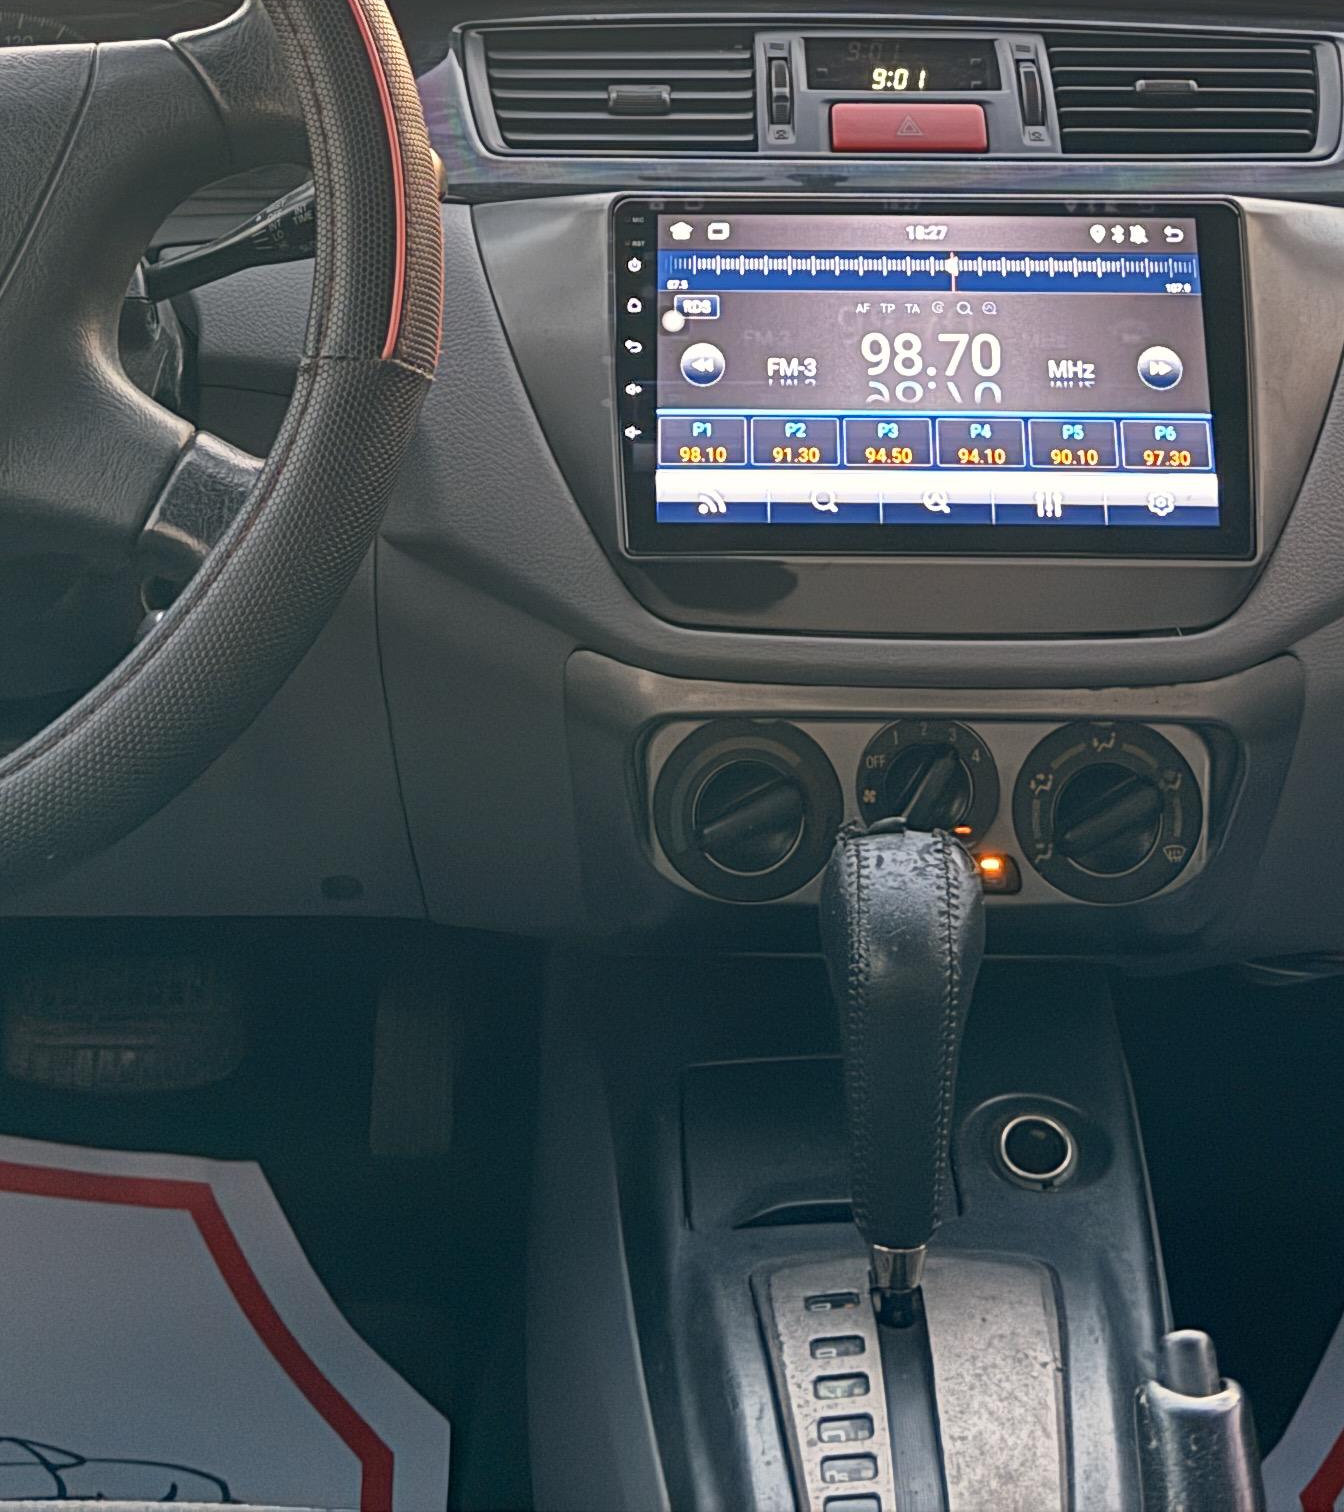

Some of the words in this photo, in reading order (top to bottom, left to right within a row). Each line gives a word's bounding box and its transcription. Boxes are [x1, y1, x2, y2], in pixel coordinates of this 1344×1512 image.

[872, 67, 926, 90] 9:01
[682, 299, 712, 314] RDS
[855, 302, 871, 314] AF
[880, 302, 896, 314] TP
[904, 303, 920, 314] TA
[766, 357, 818, 377] FM-3
[860, 332, 1002, 377] 98.70
[1047, 359, 1096, 379] MHz
[692, 422, 712, 437] P1
[785, 422, 807, 438] P2
[877, 423, 899, 438] P3
[969, 424, 992, 439] P4
[1062, 425, 1084, 440] P5
[1154, 426, 1177, 441] P6
[679, 446, 727, 463] 98.10
[772, 447, 820, 463] 91.30
[864, 447, 913, 464] 94.50
[957, 448, 1006, 464] 94.10
[1050, 449, 1099, 465] 90.10
[1143, 450, 1191, 466] 97.30
[865, 754, 886, 768] OFF
[971, 748, 981, 763] 4
